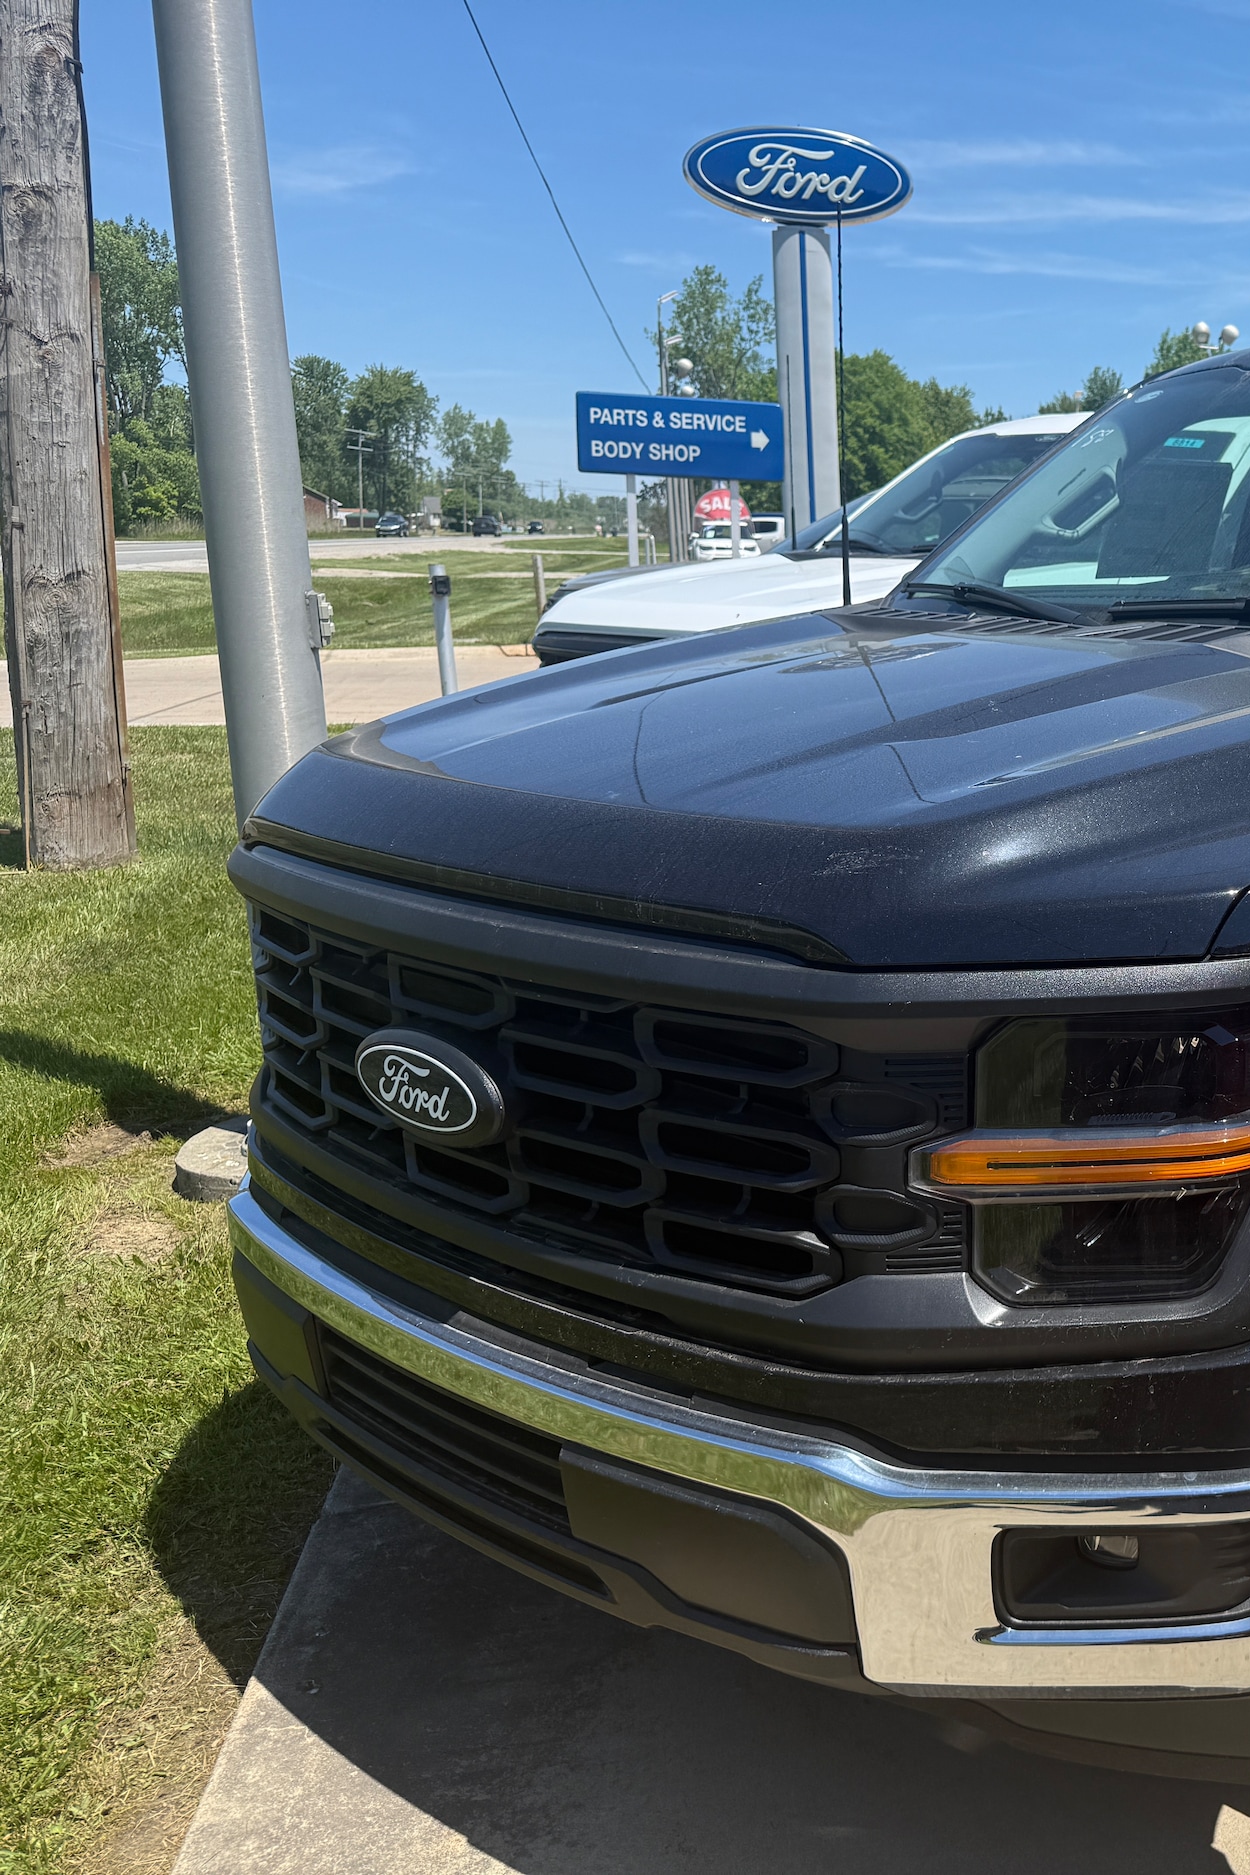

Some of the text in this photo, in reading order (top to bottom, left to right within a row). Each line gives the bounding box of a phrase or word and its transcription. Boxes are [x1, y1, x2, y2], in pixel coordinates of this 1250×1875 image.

[736, 143, 867, 203] Ford
[589, 407, 746, 433] PARTS & SERVICE
[591, 440, 700, 462] BODY SHOP
[379, 1054, 450, 1121] Ford
